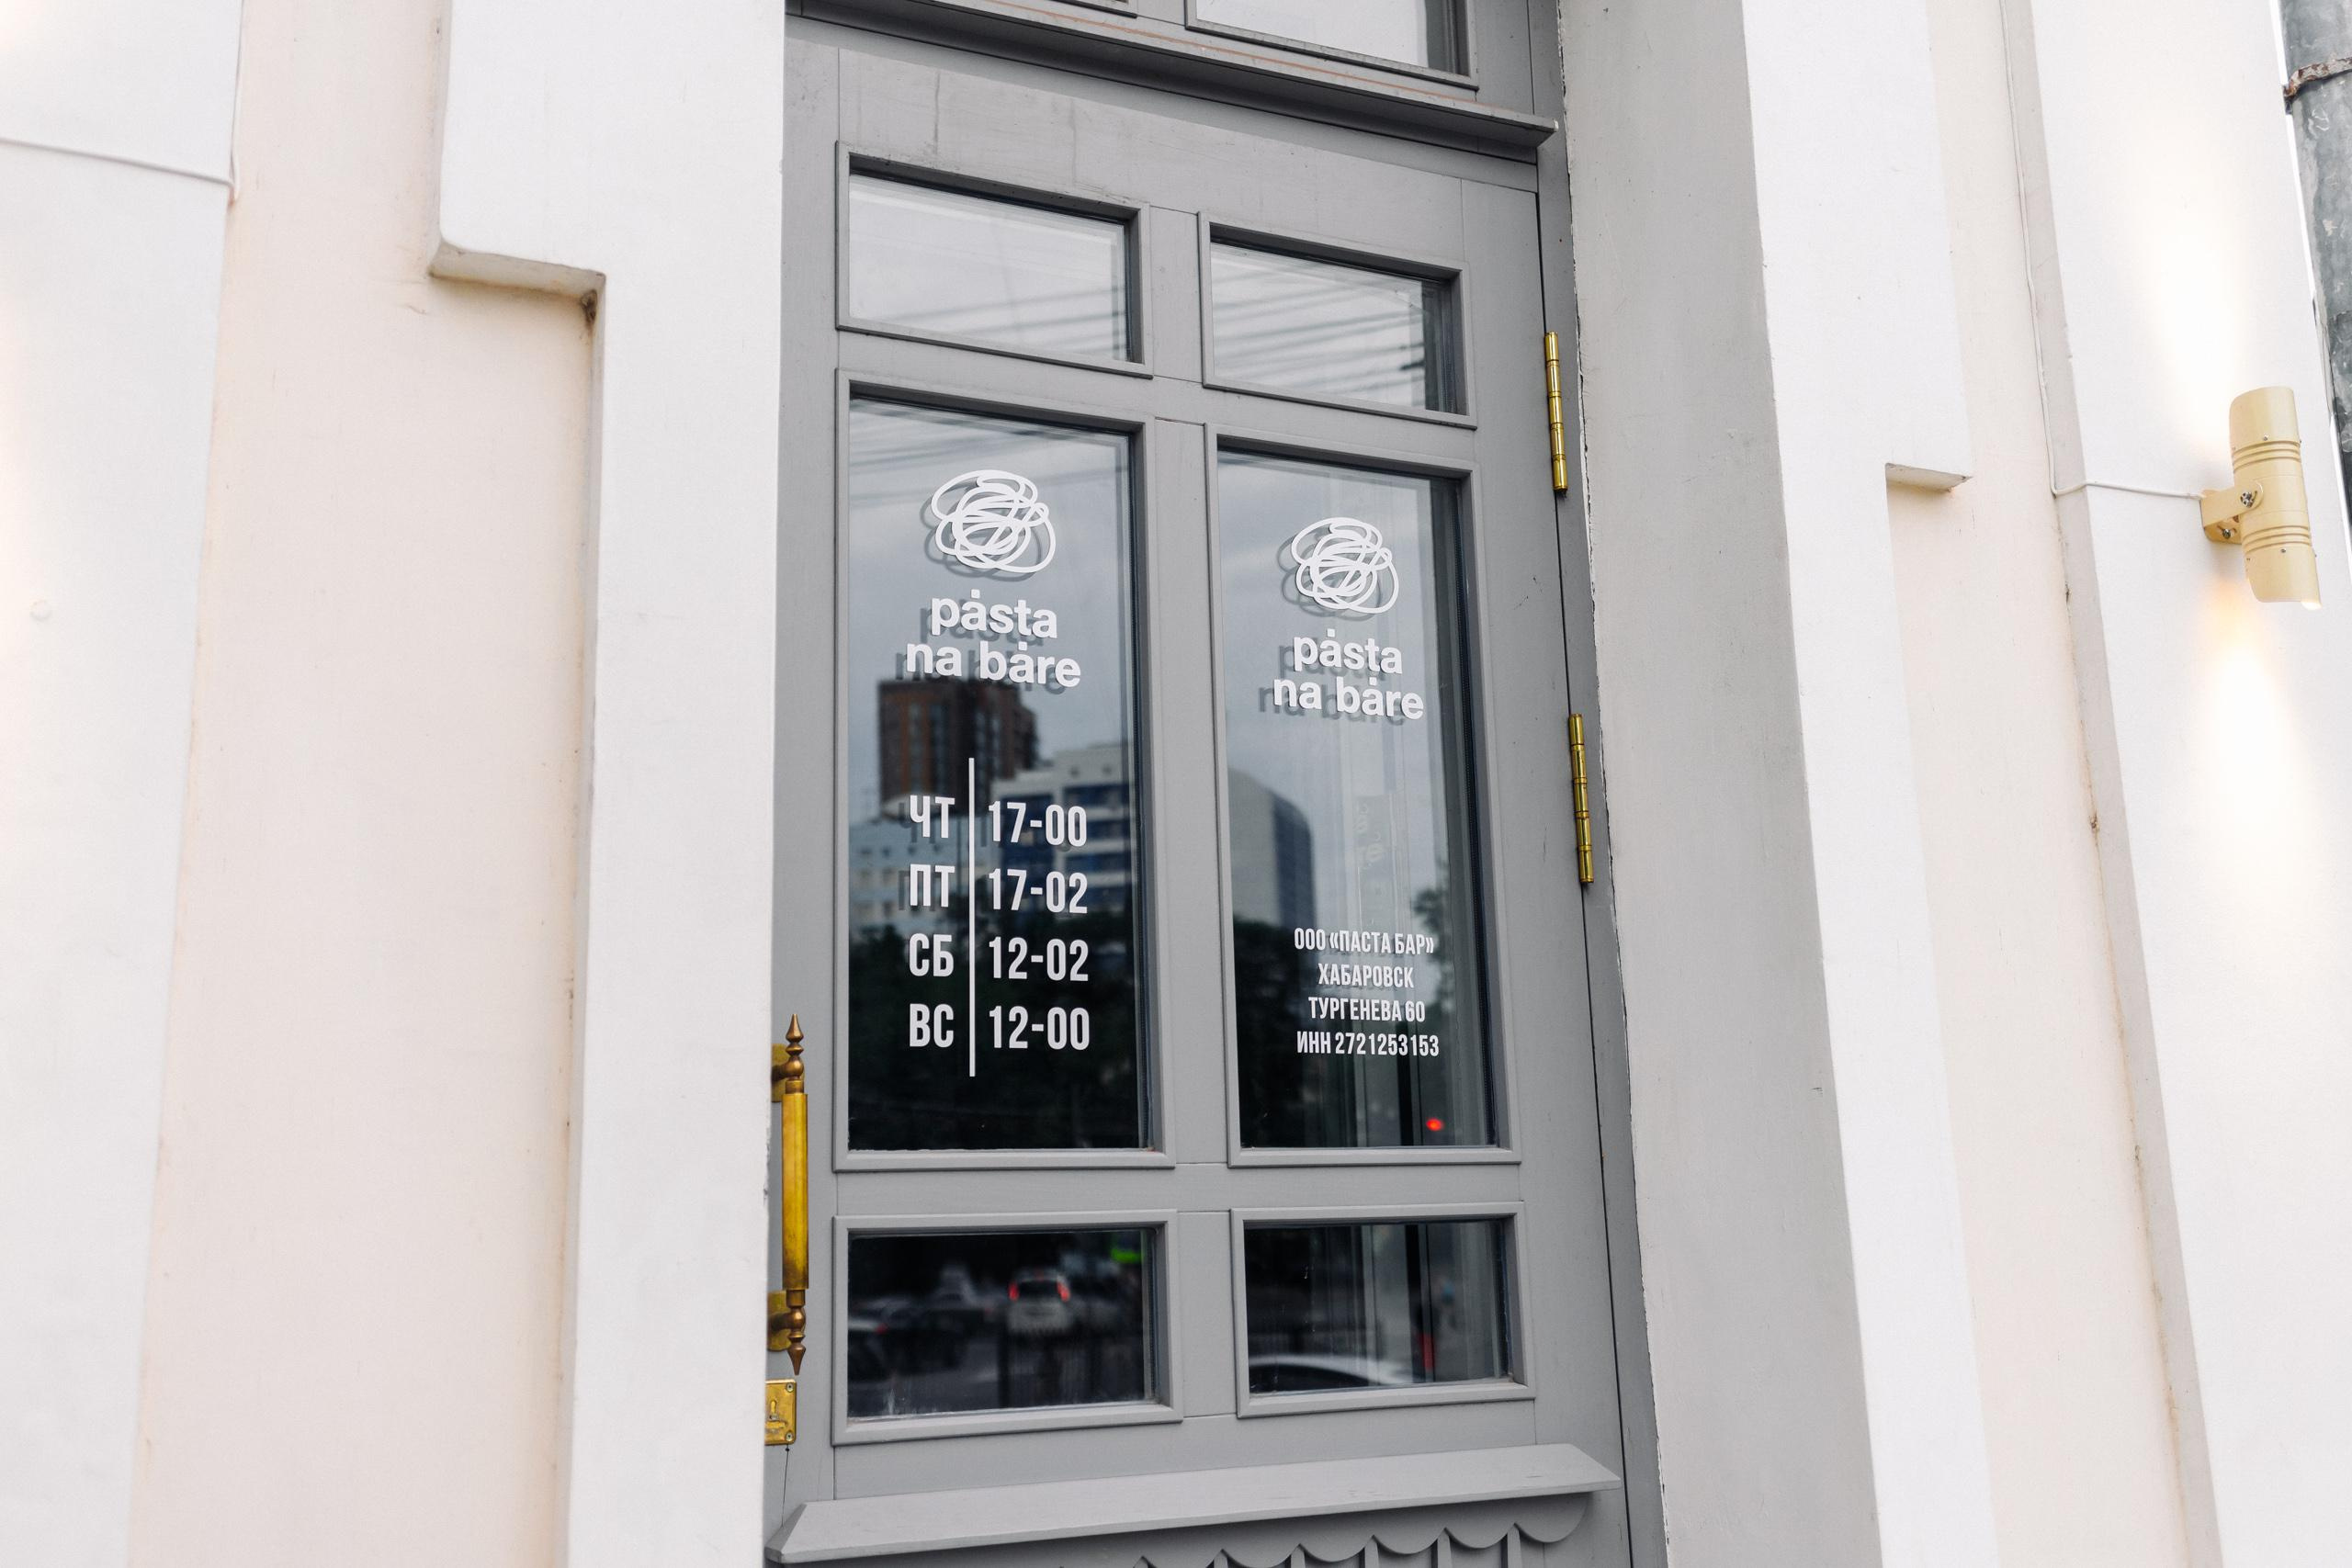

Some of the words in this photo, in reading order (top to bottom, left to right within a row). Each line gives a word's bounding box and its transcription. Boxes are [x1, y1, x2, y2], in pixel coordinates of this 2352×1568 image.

[906, 642, 962, 677] na
[1273, 678, 1321, 709] na
[909, 795, 956, 839] ЧТ
[988, 800, 1087, 847] 17-00
[909, 863, 956, 908] ПТ
[988, 868, 1088, 914] 17-02
[909, 932, 955, 977] СБ
[989, 936, 1089, 982] 12-02
[1295, 928, 1326, 951] ООО
[1329, 930, 1391, 954] «ПАСТА
[1395, 933, 1434, 954] БАР»
[1317, 963, 1415, 988] ХАБАРОВСК
[1308, 997, 1402, 1021] ТУРГЕНЕВА
[1405, 1002, 1426, 1022] 60
[909, 1003, 955, 1048] ВС
[989, 1005, 1091, 1051] 12-00
[1296, 1031, 1331, 1055] ИНН
[1335, 1032, 1440, 1056] 2721253153
